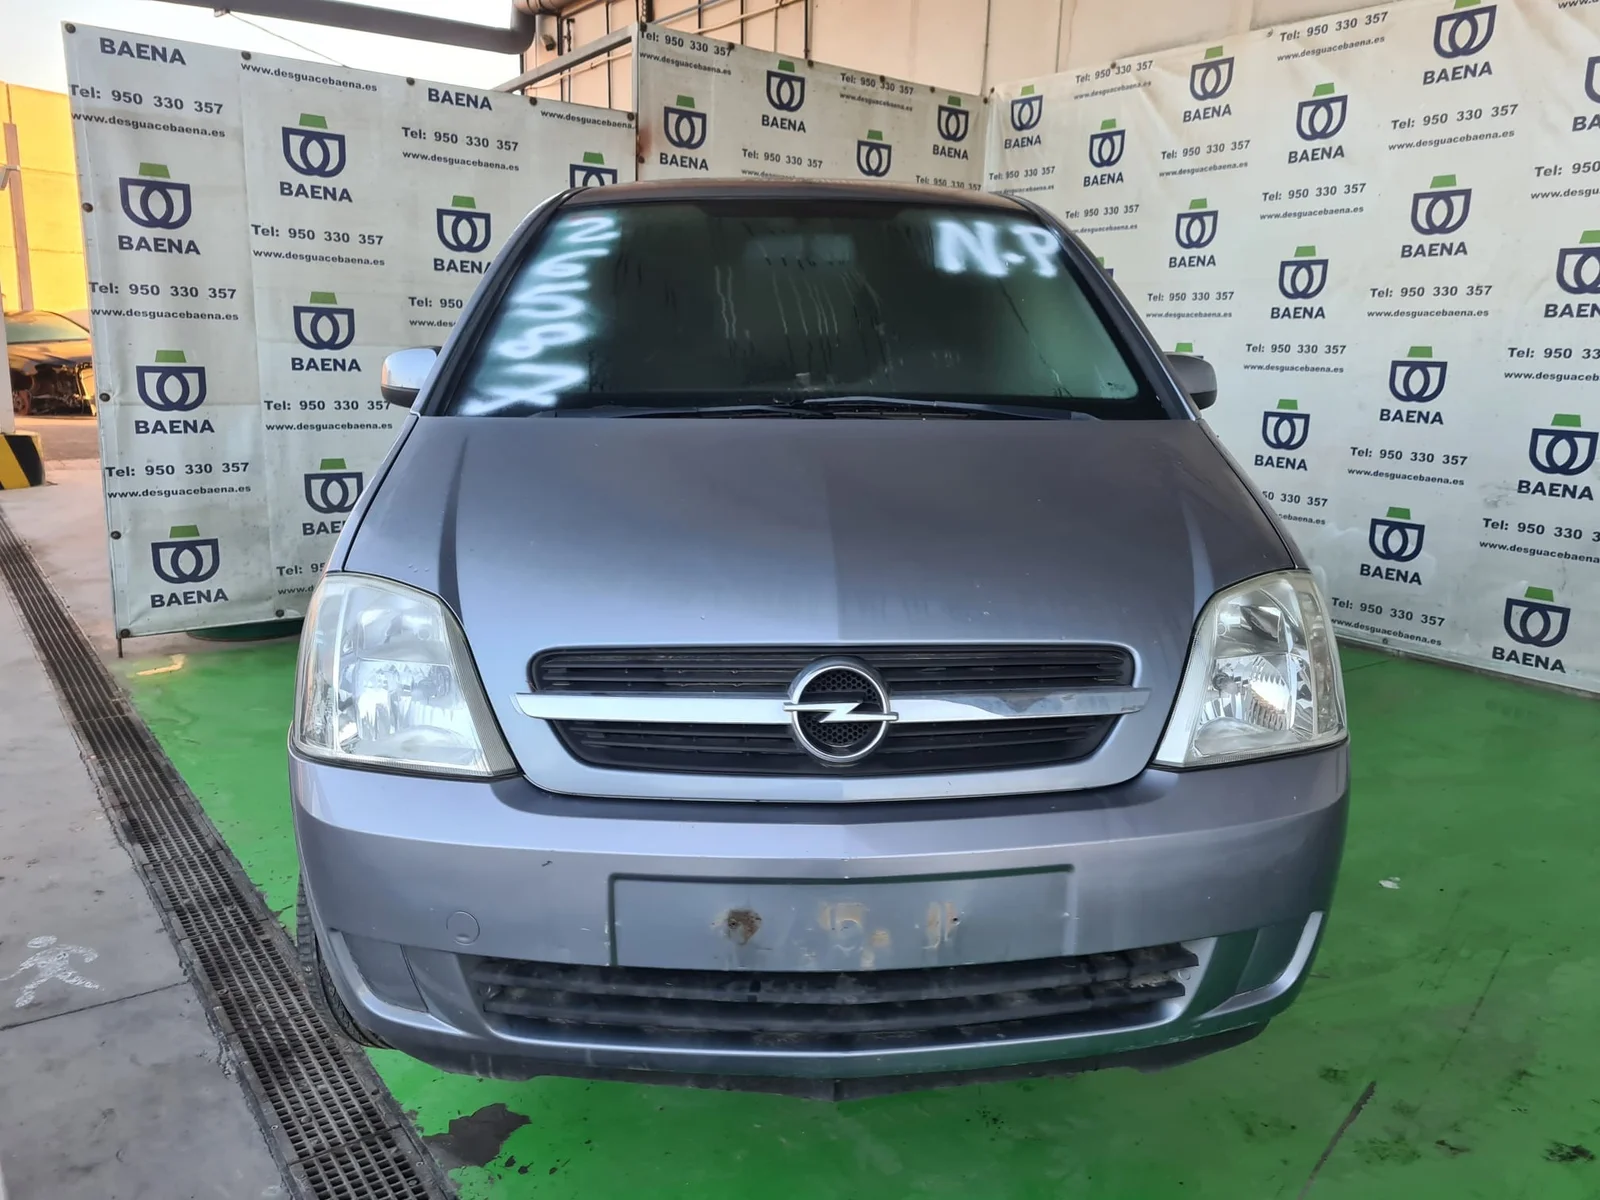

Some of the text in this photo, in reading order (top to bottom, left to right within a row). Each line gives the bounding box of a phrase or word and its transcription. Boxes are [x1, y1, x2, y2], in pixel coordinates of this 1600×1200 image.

[1280, 11, 1388, 42] Tel: 950 330 357
[100, 37, 186, 65] BAENA
[640, 31, 732, 56] Tel: 950 330 357
[1277, 36, 1385, 61] www.desguacebaena.es
[640, 52, 731, 75] www.desguacebaena.es
[1076, 60, 1153, 84] Tel: 950 330 357
[241, 63, 377, 91] www.desguacebaena.es
[1423, 61, 1492, 85] BAENA
[840, 72, 914, 95] Tel: 950 330 357
[71, 84, 223, 114] Tel: 950 330 357
[428, 88, 492, 111] BAENA
[541, 110, 635, 130] www.desguacebaena.
[1183, 104, 1232, 123] BAENA
[1391, 104, 1518, 130] Tel: 950 330 357
[71, 113, 225, 137] www.desguacebaena.es
[762, 114, 806, 133] BAENA
[401, 127, 518, 151] Tel: 950 330 357
[1004, 135, 1041, 149] BAENA
[1388, 130, 1514, 150] www.desguacebaena.es
[742, 148, 823, 169] Tel: 950 330 357
[932, 144, 968, 160] BAENA
[1161, 139, 1250, 160] Tel: 950 330 357
[1288, 145, 1345, 164] BAENA
[402, 152, 519, 171] www.desguacebaena.es
[660, 152, 709, 171] BAENA
[1159, 162, 1248, 177] www.desguacebaena.es
[1534, 160, 1600, 177] Tel: 950
[1006, 170, 1020, 179] 950
[1024, 168, 1038, 178] 330
[1041, 166, 1056, 176] 357
[1083, 172, 1124, 187] BAENA
[280, 181, 353, 203] BAENA
[1262, 183, 1366, 201] Tel: 950 330 357
[1065, 204, 1140, 219] Tel: 950 330 357
[1260, 207, 1364, 220] www.desguacebaena.es
[251, 224, 383, 245] Tel: 950 330 357
[118, 235, 201, 255] BAENA
[1401, 241, 1467, 258] BAENA
[253, 250, 385, 266] www.desguacebaena.es
[1169, 255, 1216, 268] BAENA
[89, 282, 236, 299] Tel: 950 330 357
[1147, 291, 1234, 301] Tel: 950 330 357
[1370, 285, 1492, 298] Tel: 950 330 357
[408, 296, 463, 309] Tel: 950
[91, 308, 239, 320] www.desguacebaena.es
[1146, 311, 1232, 320] www.desguacebaena.es
[1271, 306, 1325, 319] BAENA
[1367, 309, 1489, 319] www.desguacebaena.es
[1246, 343, 1346, 354] Tel: 950 330 357
[1508, 348, 1534, 358] Tel:
[1544, 348, 1572, 358] 950
[291, 357, 361, 372] BAENA
[1244, 364, 1344, 373] www.desguacebaena.es
[264, 400, 391, 410] Tel: 950 330 357
[1379, 409, 1443, 425] BAENA
[134, 419, 215, 434] BAENA
[266, 422, 393, 432] www.desguacebaena.es
[1254, 454, 1307, 471] BAENA
[1350, 447, 1468, 466] Tel: 950 330 357
[105, 462, 249, 477] Tel: 950 330 357
[1348, 469, 1464, 485] www.desguacebaena.es
[107, 486, 251, 499] www.desguacebaena.es
[1517, 480, 1594, 501] BAENA
[1280, 493, 1300, 504] 330
[1307, 496, 1328, 507] 357
[302, 520, 346, 536] BAE
[1482, 518, 1509, 530] Tel:
[1517, 522, 1545, 534] 950
[1554, 527, 1582, 540] 330
[276, 566, 302, 576] Tel:
[1360, 563, 1422, 585] BAENA
[151, 588, 229, 608] BAENA
[1332, 597, 1445, 627] Tel: 950 330 357
[1331, 619, 1442, 646] www.desguacebaena.es
[1492, 646, 1566, 673] BAENA
